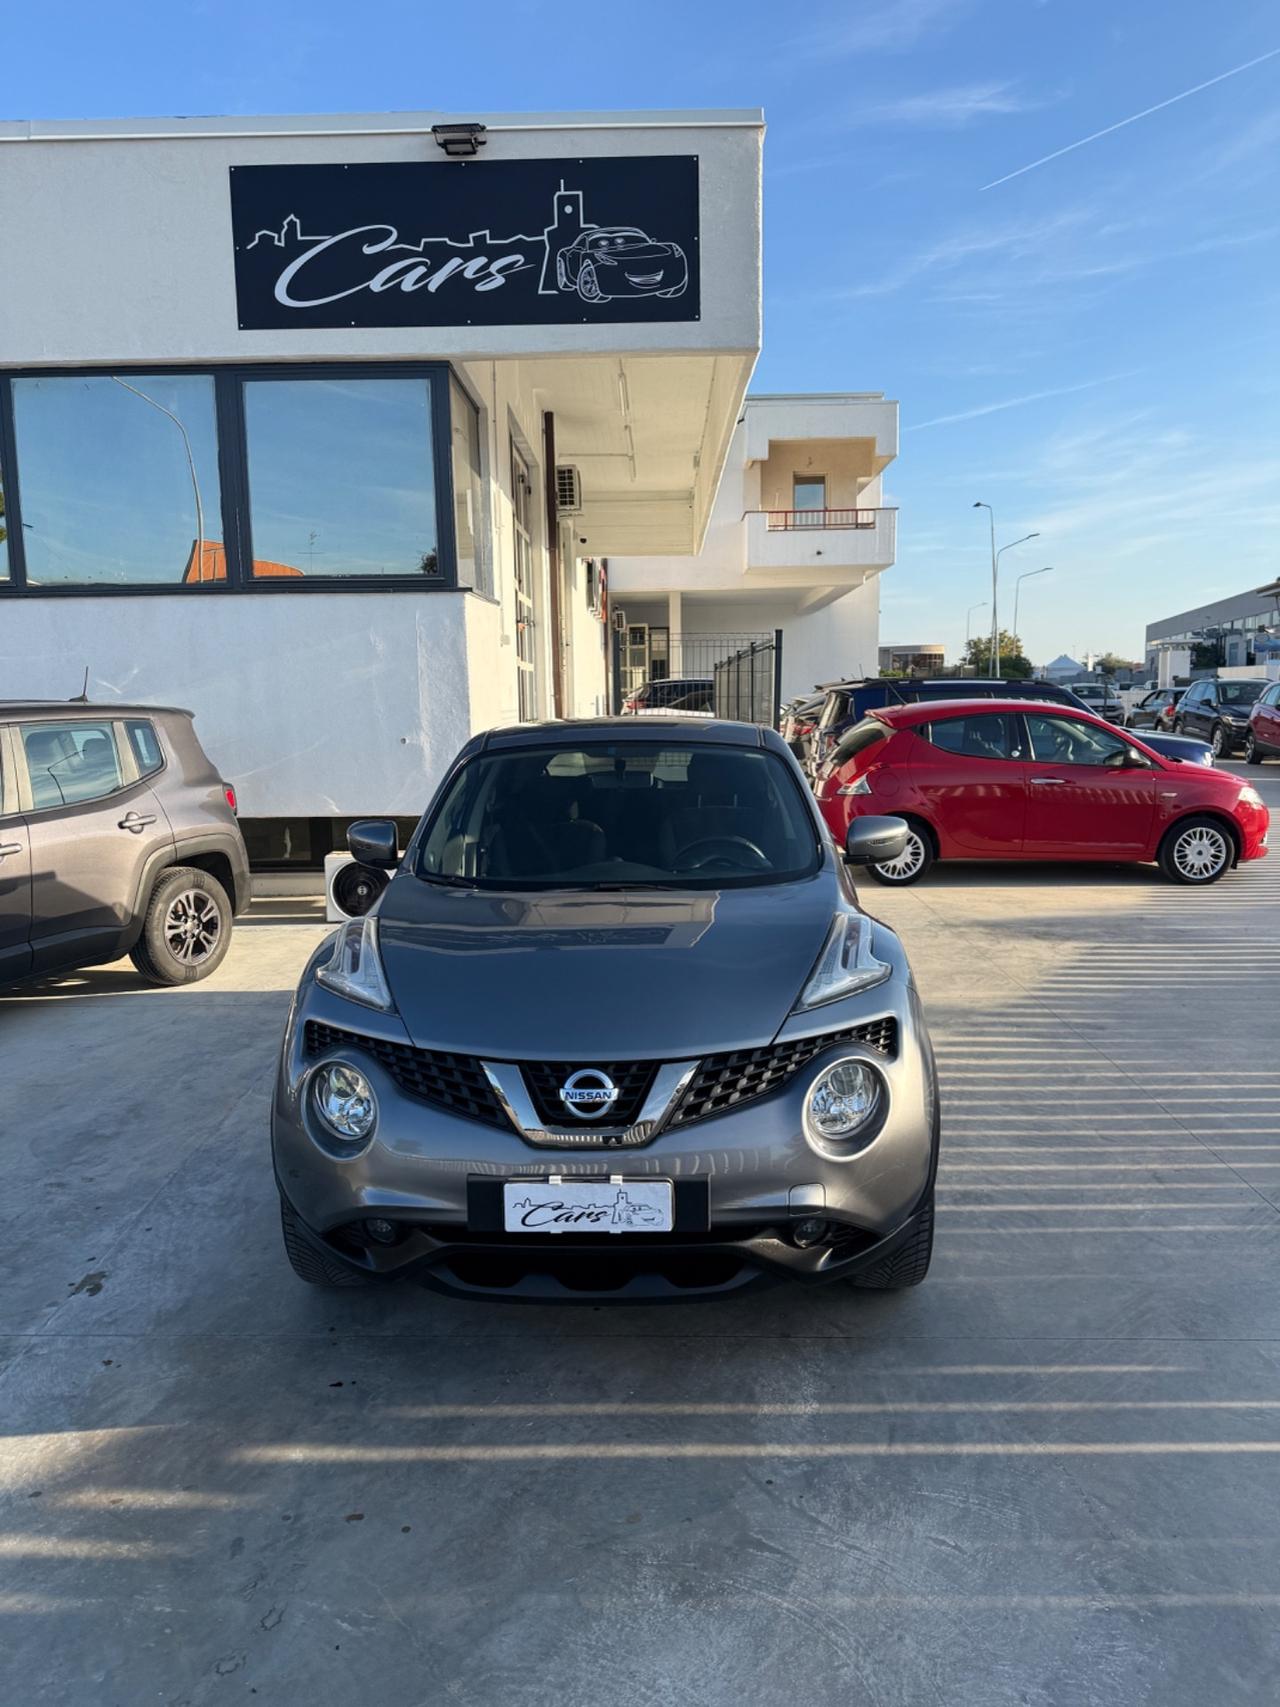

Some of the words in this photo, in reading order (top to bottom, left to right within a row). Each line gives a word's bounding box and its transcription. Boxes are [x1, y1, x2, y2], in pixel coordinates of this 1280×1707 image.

[274, 224, 535, 308] Cars
[565, 1091, 612, 1100] NISSAN
[521, 1201, 610, 1227] Cars
